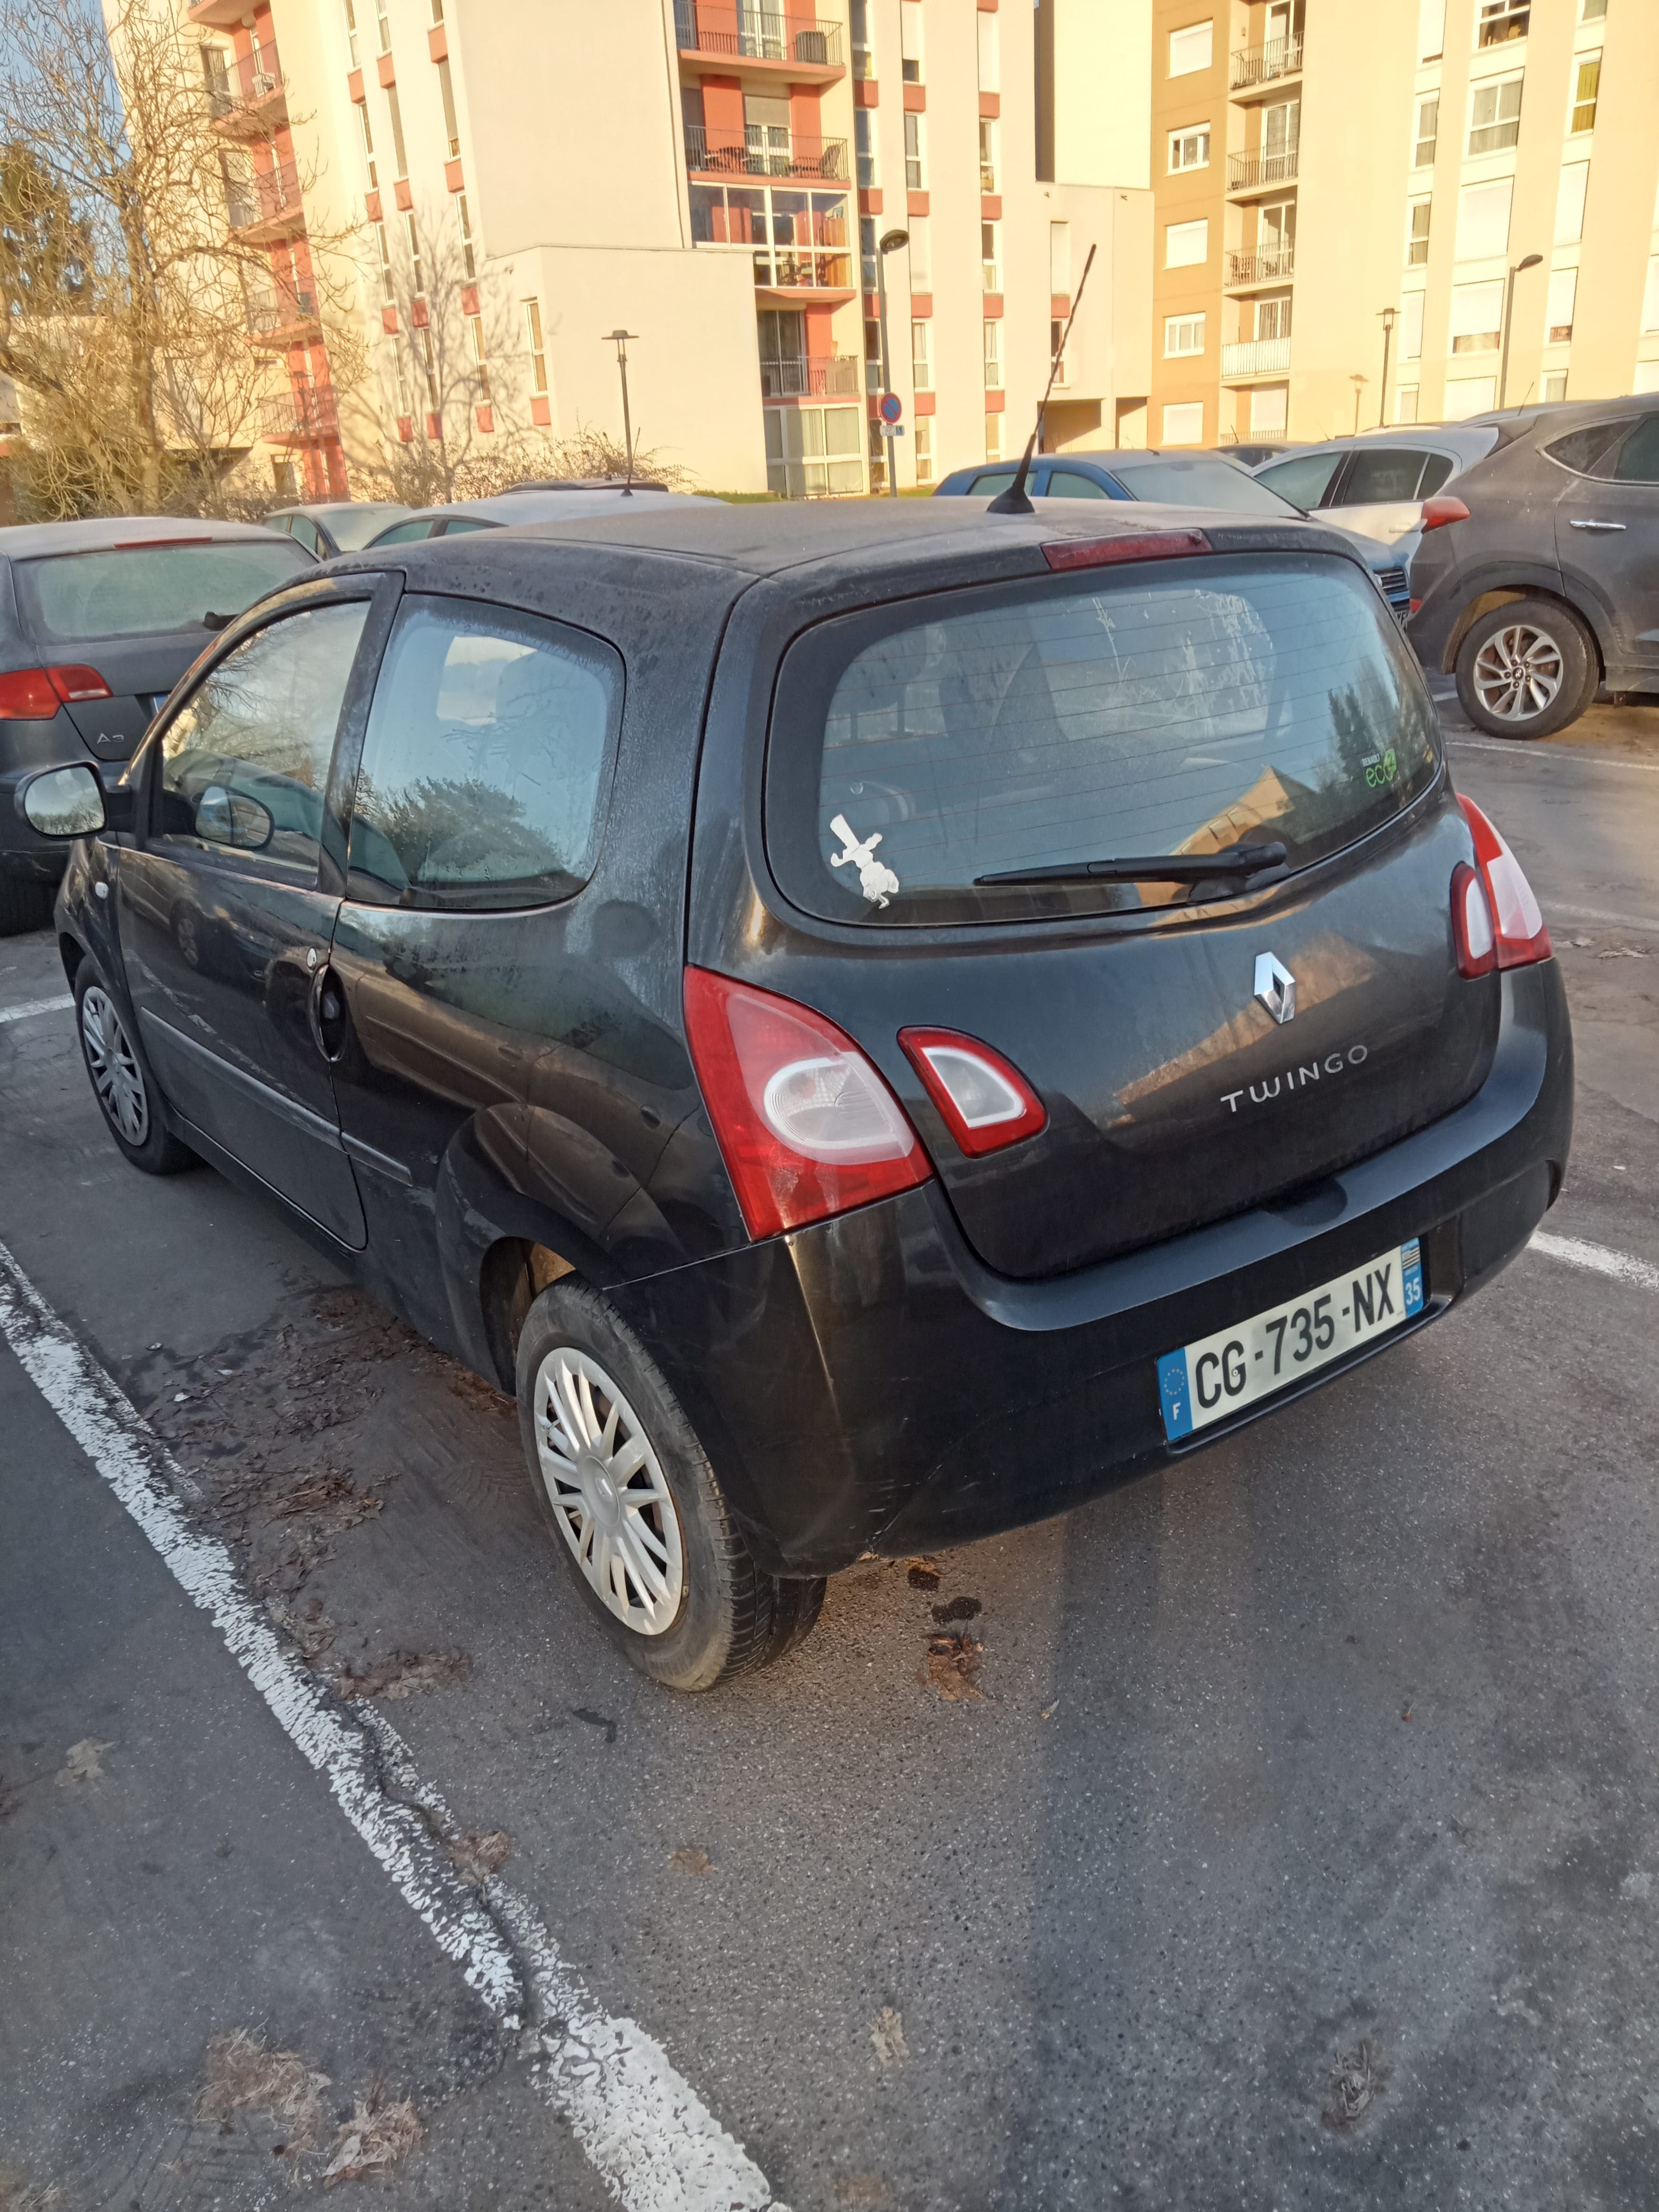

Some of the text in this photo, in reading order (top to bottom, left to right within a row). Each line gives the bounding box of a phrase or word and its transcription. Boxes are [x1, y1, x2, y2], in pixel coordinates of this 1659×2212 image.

[97, 733, 124, 744] A3
[1220, 1044, 1368, 1113] TWINGO
[1405, 1277, 1421, 1305] 35
[1195, 1263, 1395, 1409] CG-735-NX
[1172, 1402, 1182, 1421] F
